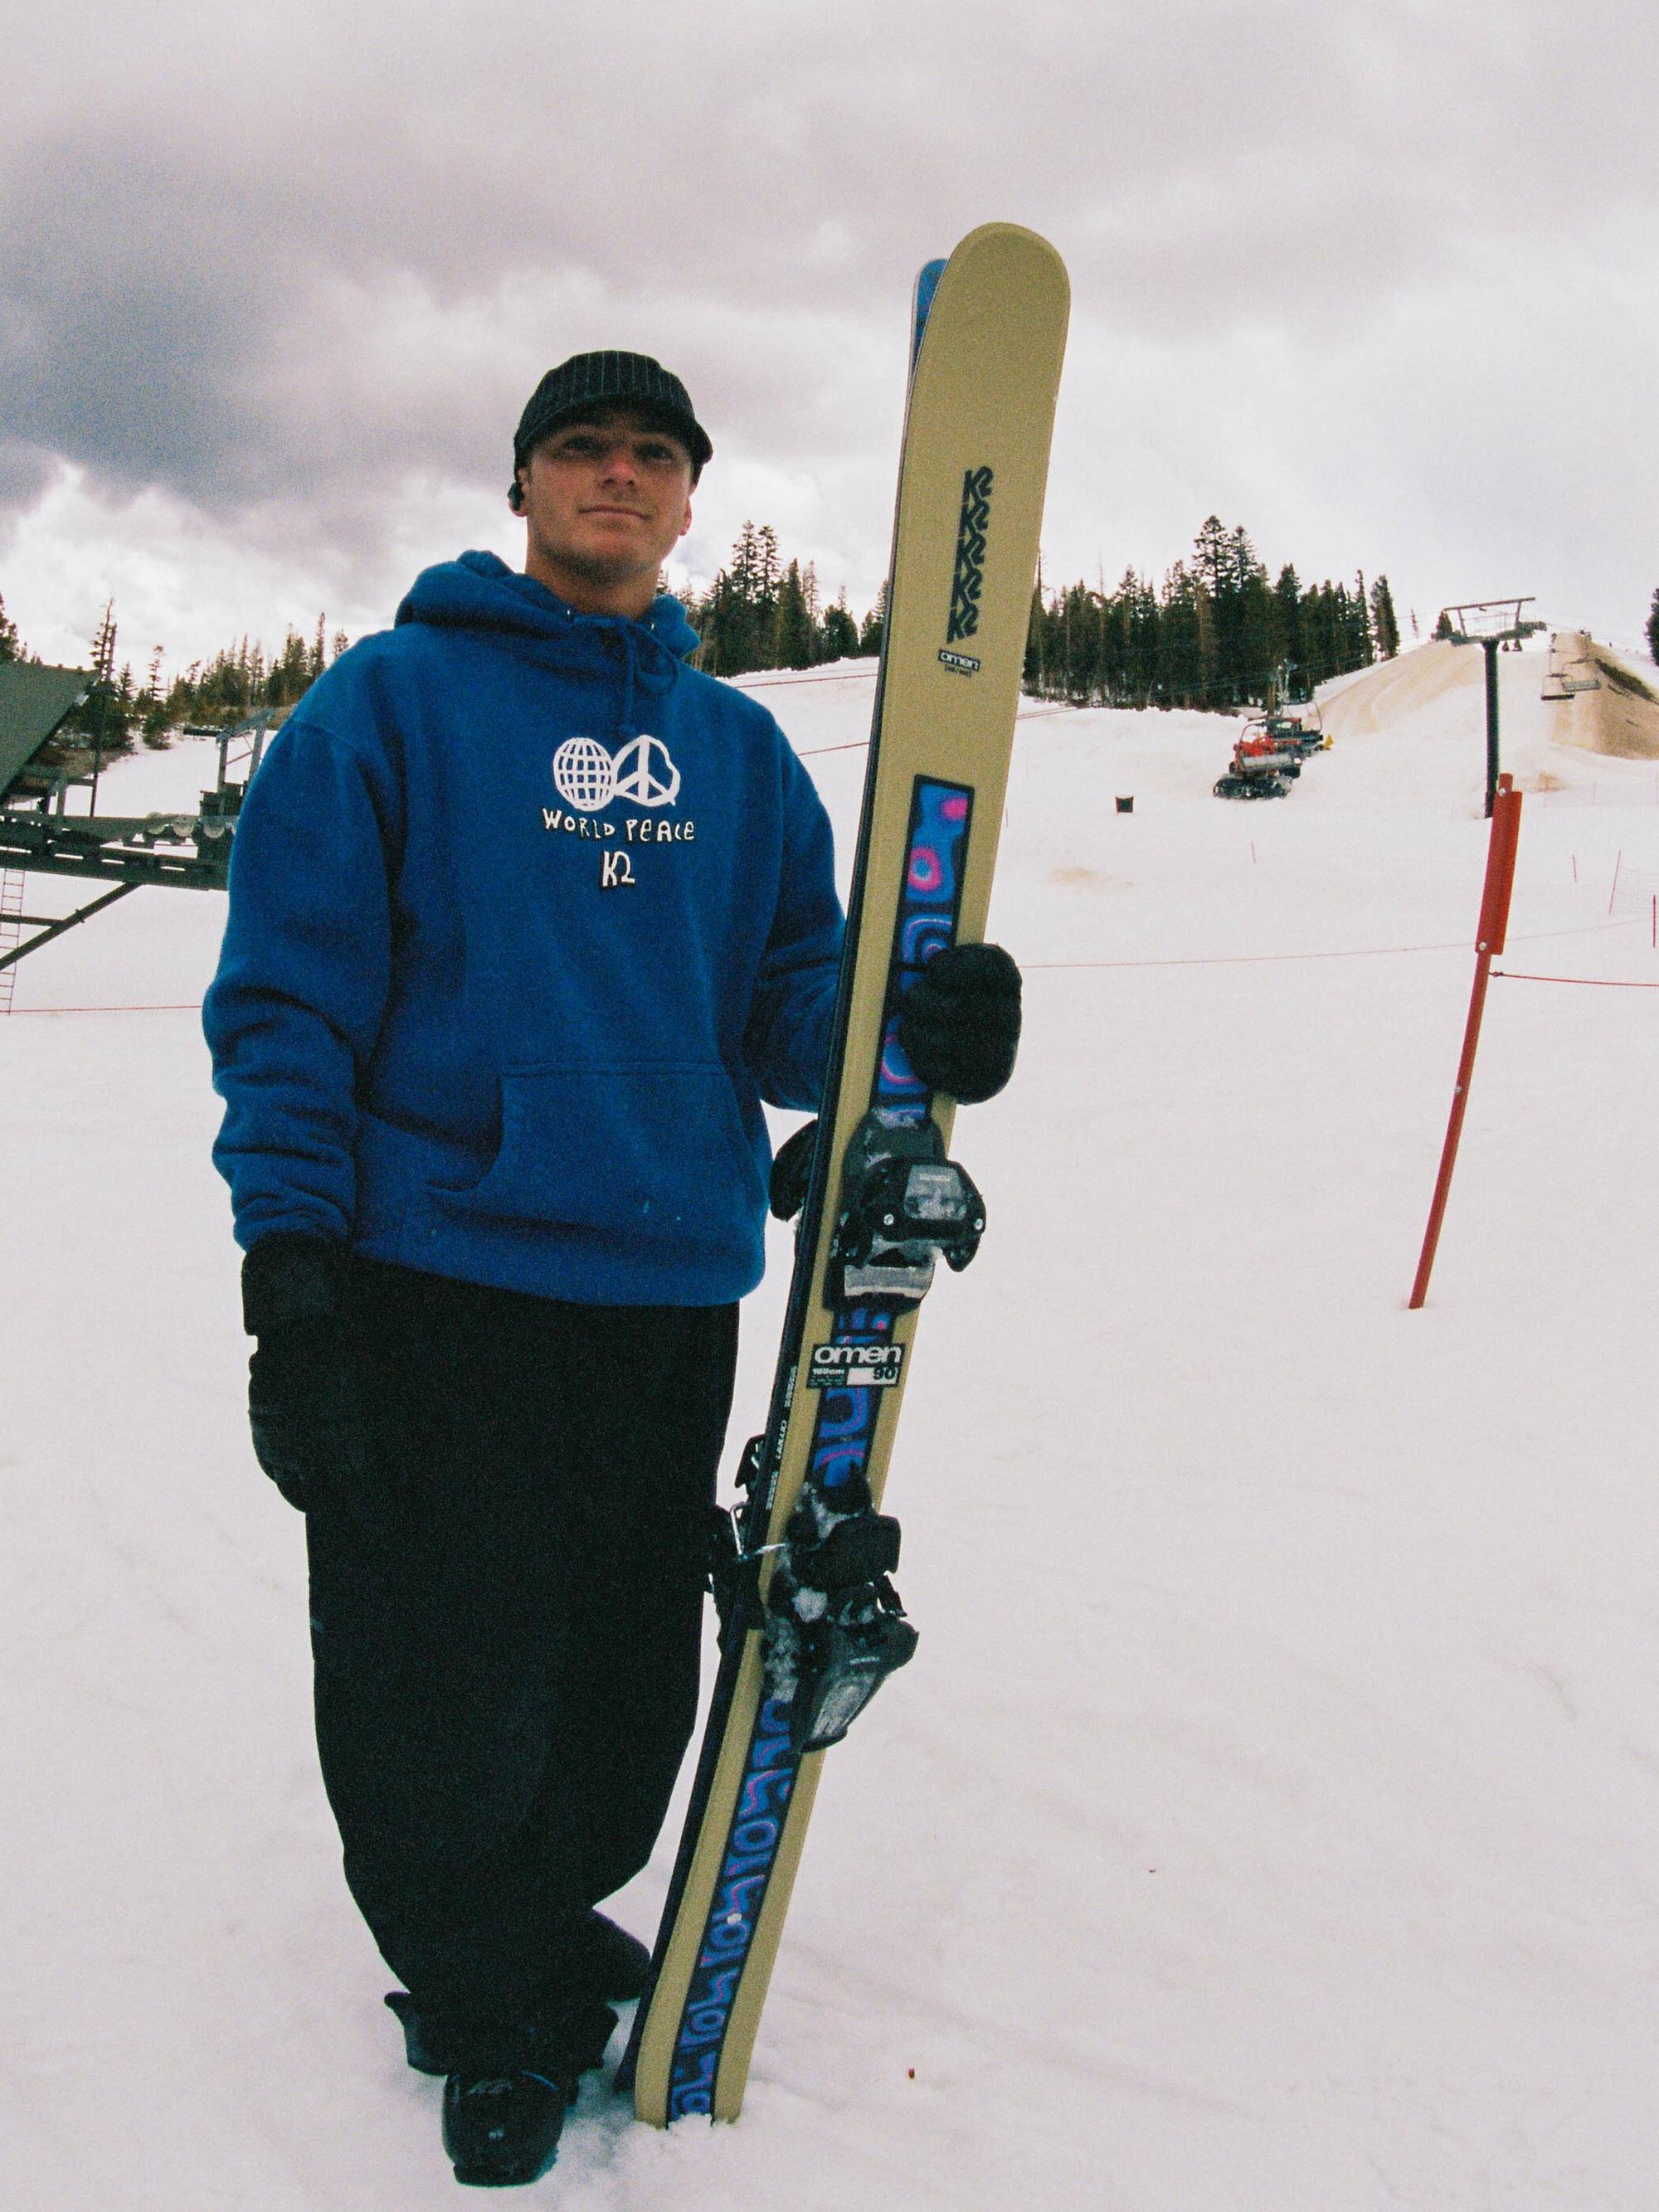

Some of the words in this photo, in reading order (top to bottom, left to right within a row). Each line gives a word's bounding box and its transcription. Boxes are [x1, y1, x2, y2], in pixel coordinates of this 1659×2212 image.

[940, 650, 980, 670] omen
[542, 808, 616, 839] WORLD
[602, 850, 635, 887] K2
[814, 1345, 902, 1364] omen
